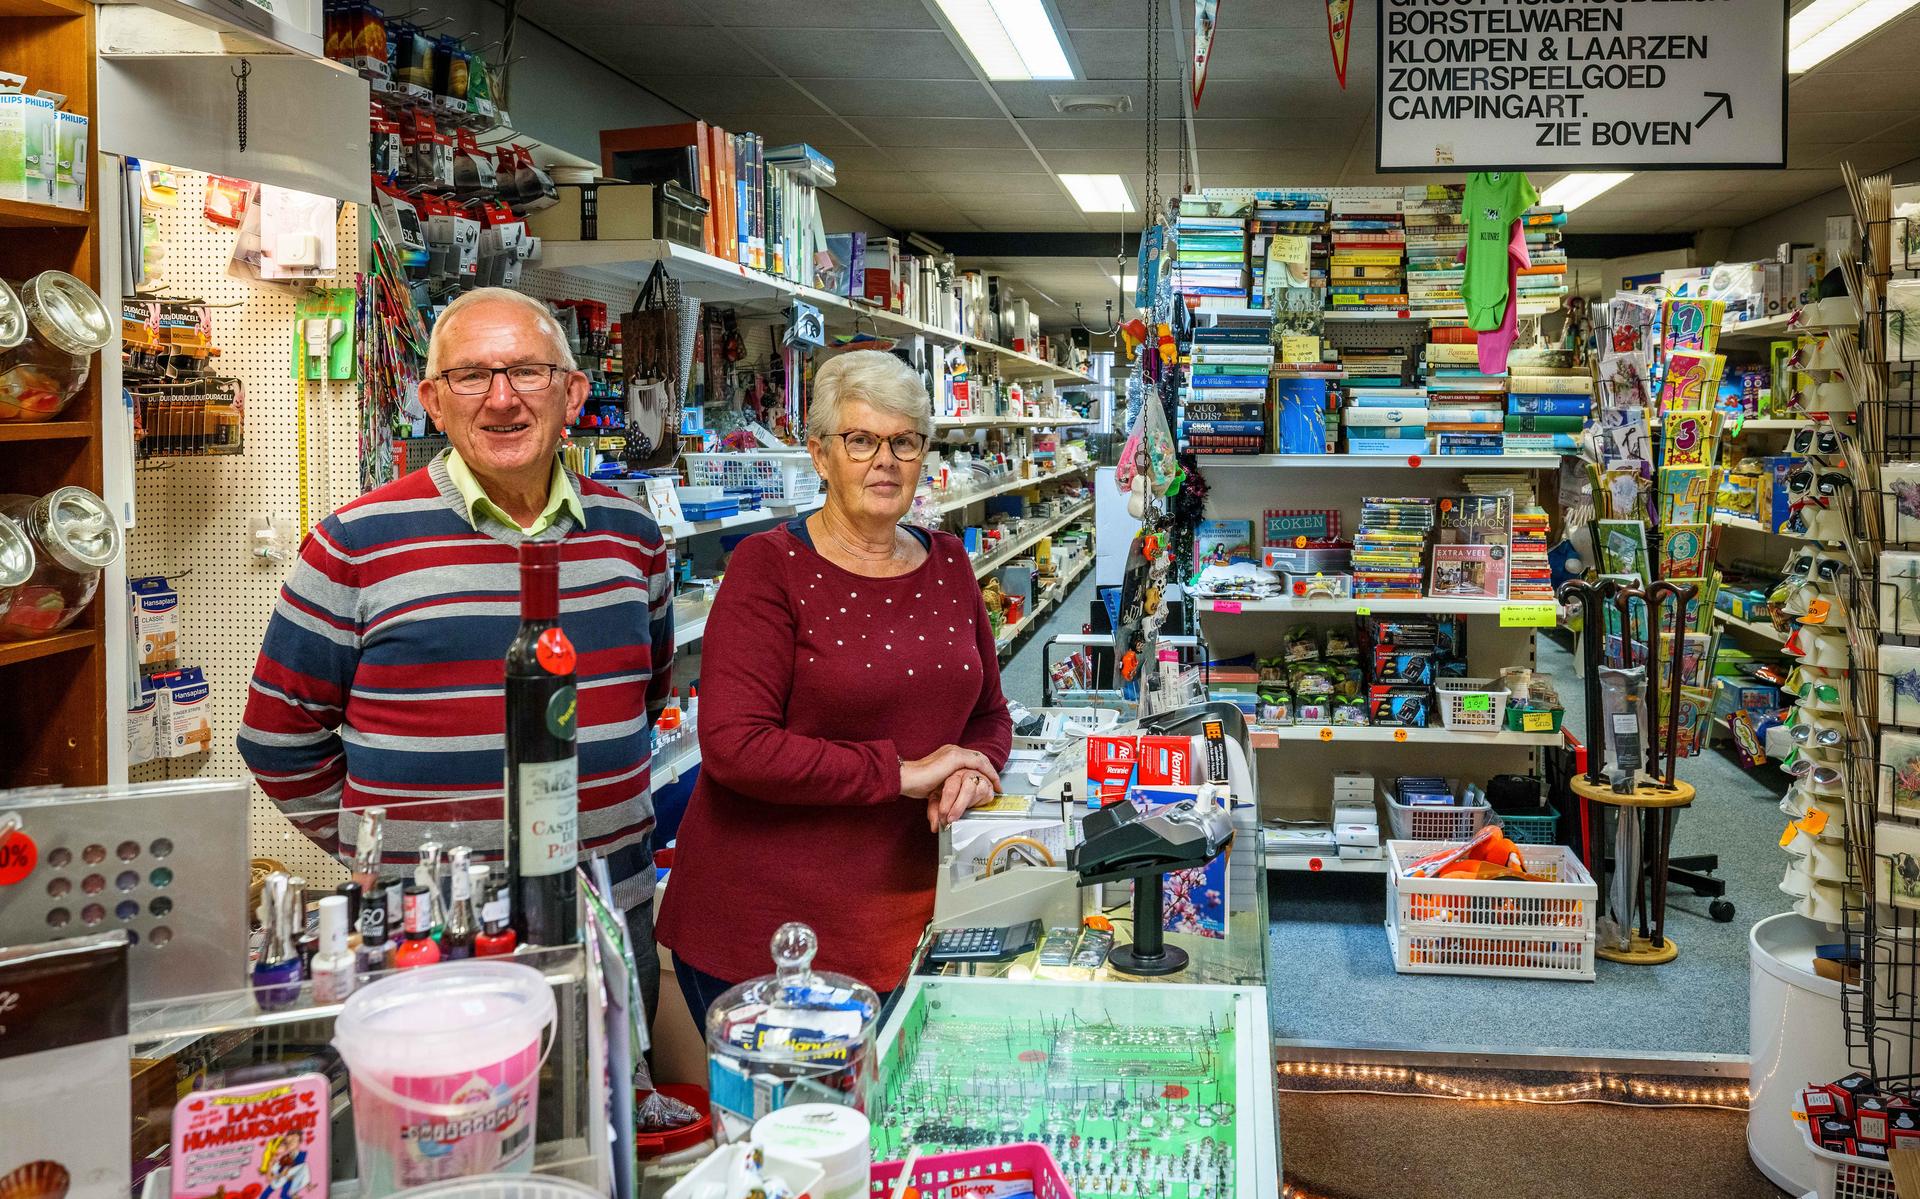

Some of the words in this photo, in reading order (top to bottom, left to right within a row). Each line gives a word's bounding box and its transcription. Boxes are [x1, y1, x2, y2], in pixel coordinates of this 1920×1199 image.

[1388, 8, 1623, 35] BORSTELWAREN
[1388, 37, 1528, 63] KLOMPEN
[1538, 37, 1560, 62] &
[1567, 36, 1708, 61] LAARZEN
[1388, 65, 1666, 91] ZOMERSPEELGOED
[25, 97, 54, 109] PHILIPS
[1388, 94, 1589, 120] CAMPINGART.
[60, 112, 88, 126] PHILIPS
[1535, 121, 1582, 147] ZIE
[1592, 121, 1692, 147] BOVEN
[123, 305, 150, 317] DURACELL
[171, 312, 200, 323] DURACELL
[1681, 366, 1707, 399] 2
[205, 393, 233, 401] DURACELL
[1194, 404, 1216, 413] QUO
[1187, 412, 1222, 421] VADIS?
[1676, 419, 1697, 450] 3
[1684, 476, 1707, 511] 4
[1271, 516, 1324, 531] KOKEN
[1440, 519, 1505, 529] DECORATION
[1674, 530, 1691, 559] 6
[143, 597, 176, 607] Hansaplast
[141, 615, 165, 624] CLASSIC
[174, 687, 208, 700] Hansaplast
[1205, 722, 1222, 740] NEE
[1106, 766, 1129, 775] Rennie
[362, 907, 385, 925] 60
[228, 1094, 297, 1124] LANGE
